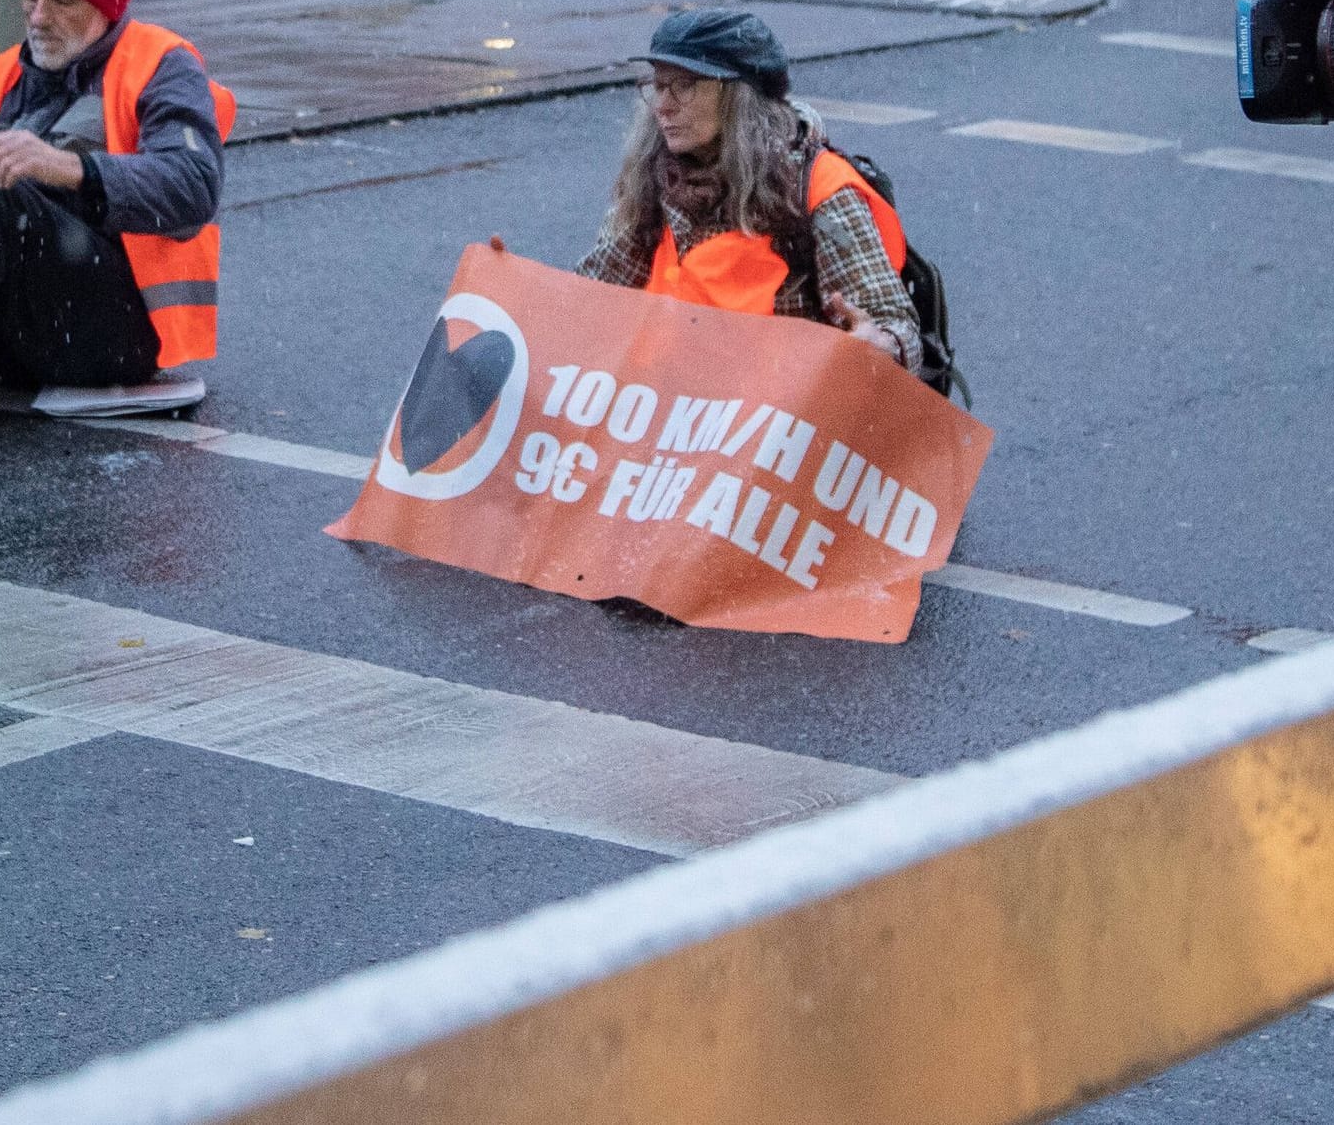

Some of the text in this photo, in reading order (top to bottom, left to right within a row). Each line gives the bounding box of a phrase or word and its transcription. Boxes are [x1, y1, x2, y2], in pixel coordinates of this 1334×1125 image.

[513, 431, 836, 591] 9€ FÜR ALLE
[543, 364, 938, 558] 100 KM/H UND
